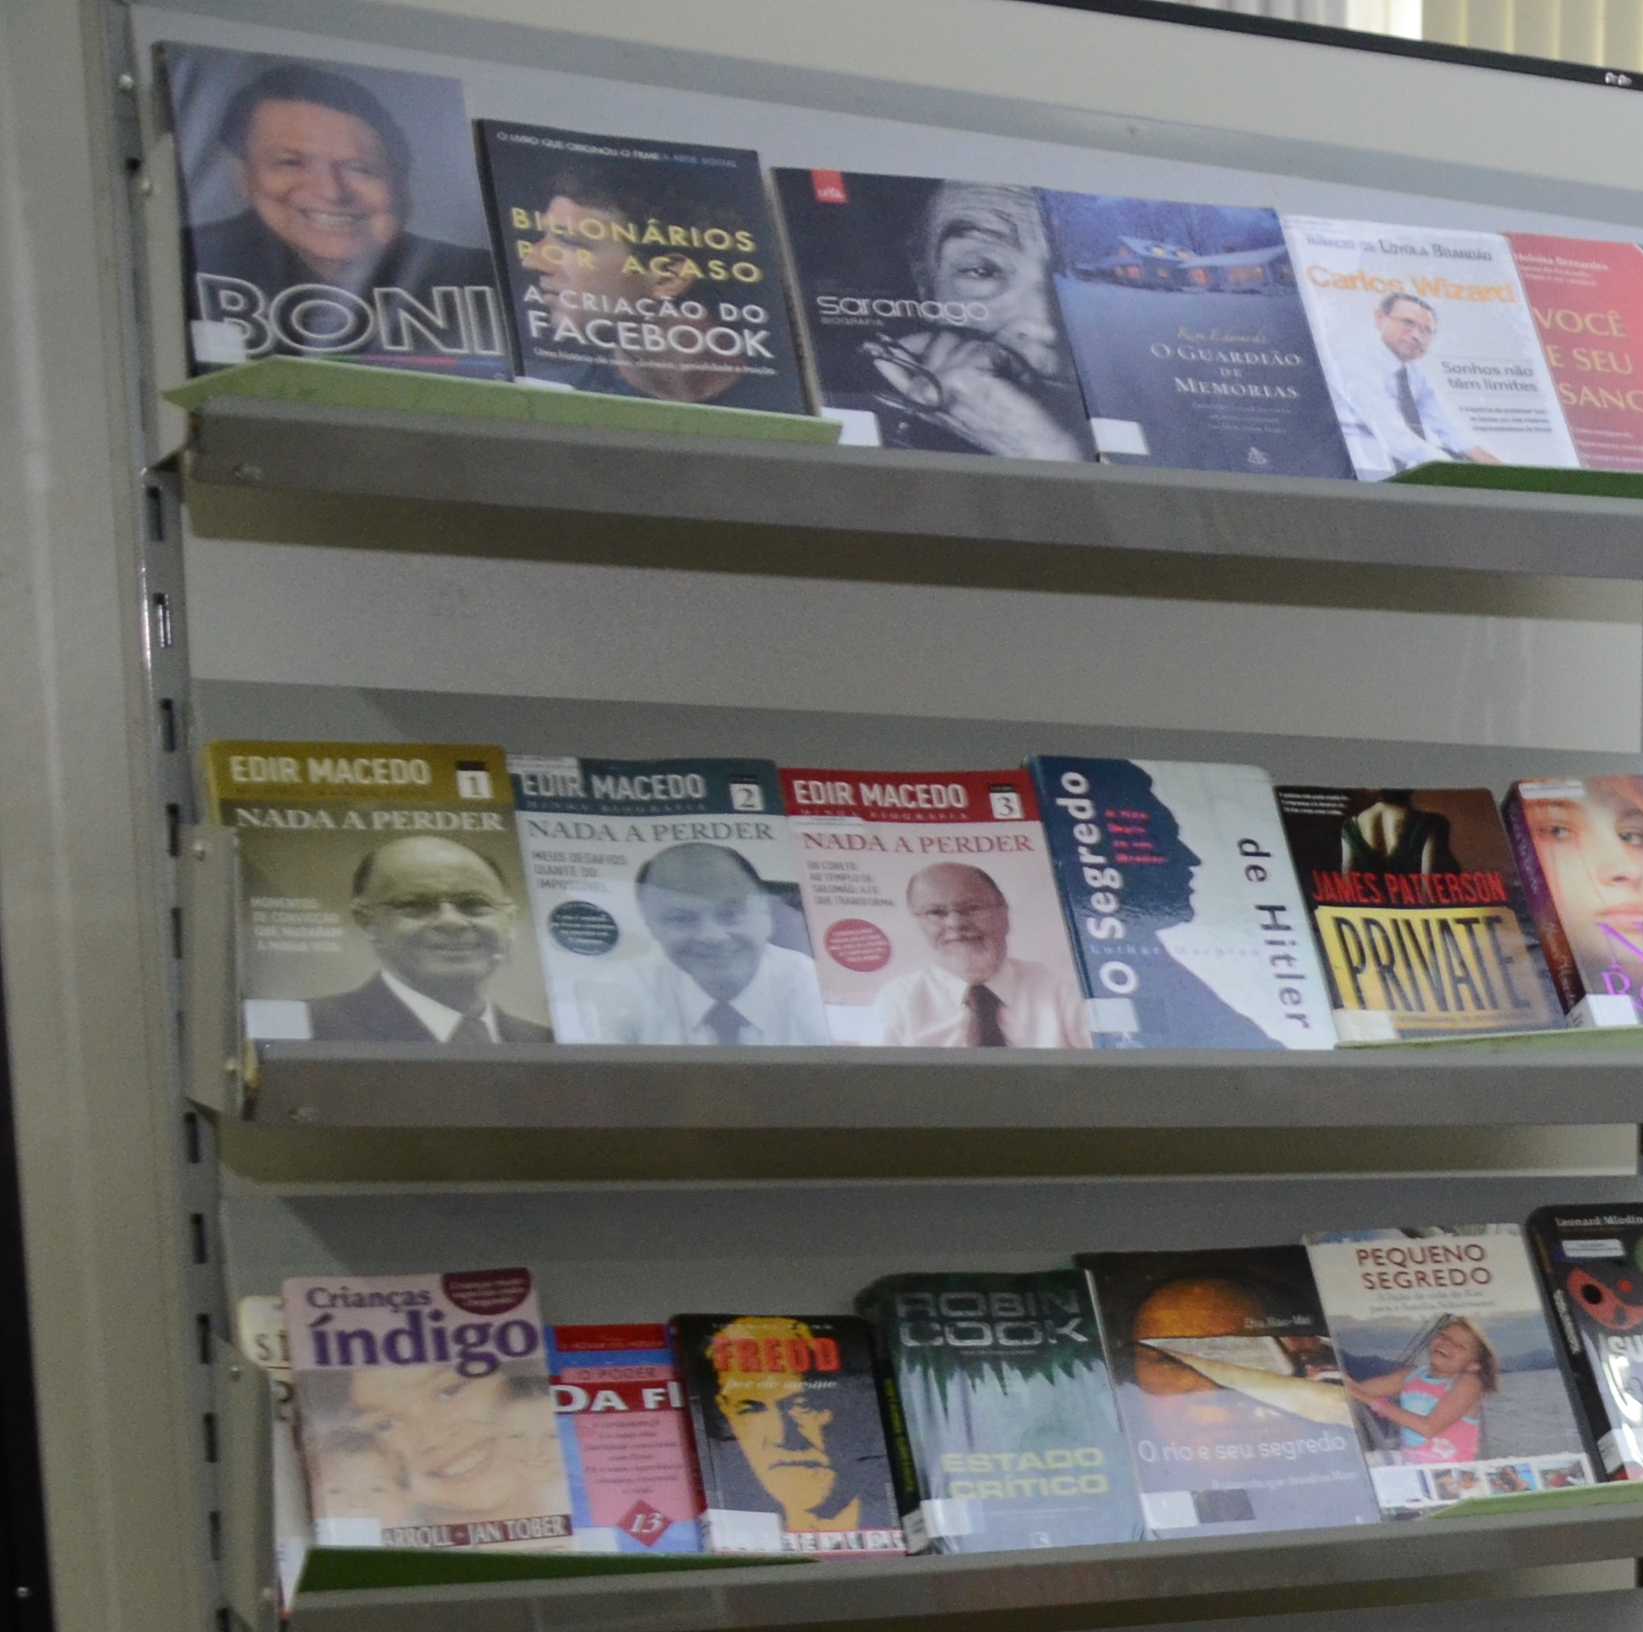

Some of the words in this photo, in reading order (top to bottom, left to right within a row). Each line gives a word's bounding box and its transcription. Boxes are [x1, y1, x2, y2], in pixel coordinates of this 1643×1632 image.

[511, 207, 757, 253] BILIONÁRIOS
[621, 253, 763, 283] ACASO
[1306, 264, 1405, 294] Carlos
[1410, 274, 1516, 303] Wizard
[197, 272, 502, 356] BONI
[559, 289, 706, 322] CRIAÇÃO
[719, 301, 768, 324] DO
[528, 310, 775, 360] FACEBOOK
[1176, 344, 1301, 367] GUARDIÃO
[1503, 364, 1535, 378] não
[1573, 346, 1634, 375] SEU
[1484, 378, 1539, 393] limites
[229, 755, 303, 784] EDIR
[307, 757, 432, 786] MACEDO
[591, 775, 707, 800] MACEDO
[793, 779, 857, 807] EDIR
[859, 781, 970, 810] MACEDO
[235, 807, 336, 830] NADA
[372, 810, 506, 832] PERDER
[527, 818, 620, 842] NADA
[651, 822, 777, 842] PERDER
[803, 832, 887, 853] NADA
[919, 834, 1035, 854] PERDER
[1055, 771, 1127, 940] segredo
[1237, 838, 1272, 884] de
[1313, 868, 1386, 905] JAMES
[1384, 869, 1508, 905] PATTERSON
[1254, 903, 1311, 1029] Hitler
[1332, 914, 1533, 1012] PRIVATE
[1555, 1214, 1601, 1227] Leonard
[1355, 1243, 1487, 1268] PEQUENO
[1361, 1266, 1493, 1291] SEGREDO
[308, 1309, 540, 1379] índigo
[901, 1317, 1090, 1348] COOK
[713, 1335, 842, 1373] FREUD
[942, 1446, 1106, 1474] ESTADO
[1258, 1430, 1347, 1463] segredo
[949, 1472, 1110, 1500] CRÍTICO
[468, 1523, 502, 1545] JAN
